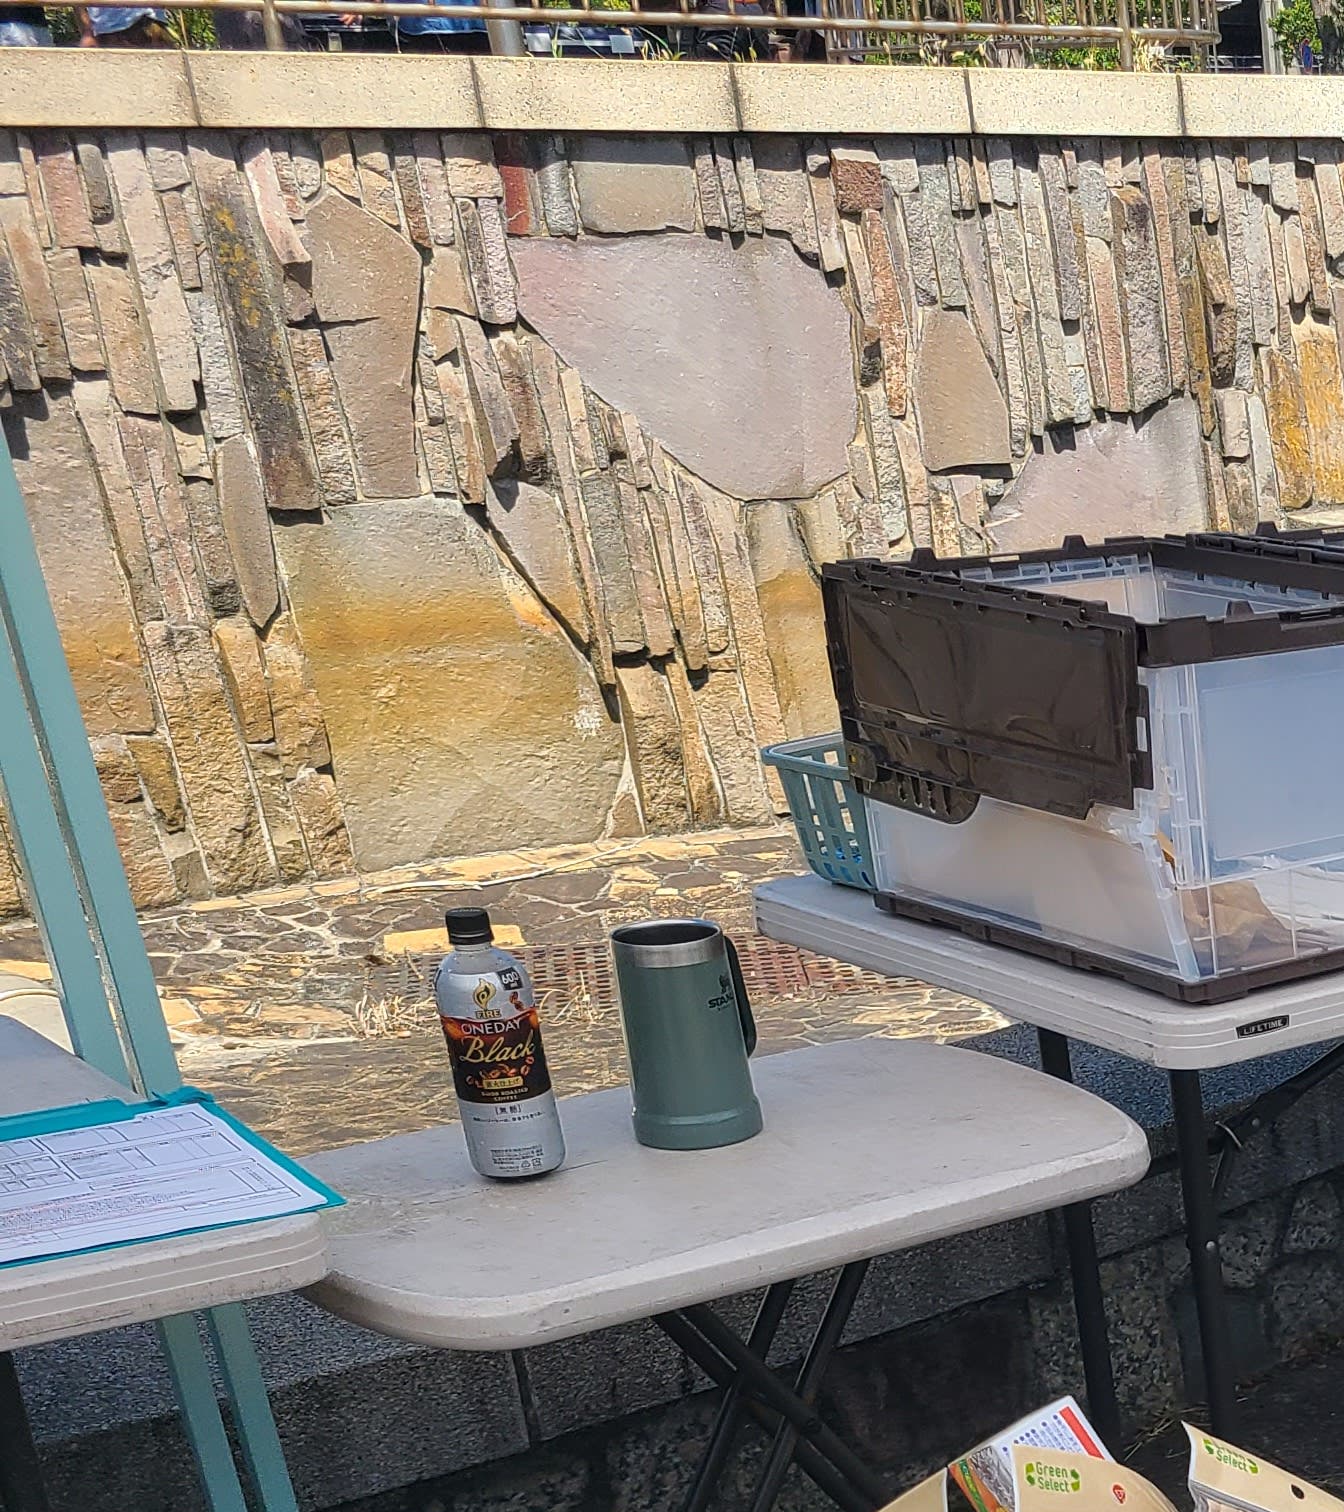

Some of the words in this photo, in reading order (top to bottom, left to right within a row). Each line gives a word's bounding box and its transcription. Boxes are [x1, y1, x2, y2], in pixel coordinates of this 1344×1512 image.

[475, 1008, 501, 1019] FIRE
[460, 1018, 522, 1036] ONEDAY
[1243, 1019, 1284, 1035] LIFETIME
[459, 1028, 534, 1064] Black
[1035, 1460, 1069, 1479] Green
[1215, 1450, 1248, 1473] Select
[1036, 1475, 1070, 1493] Select
